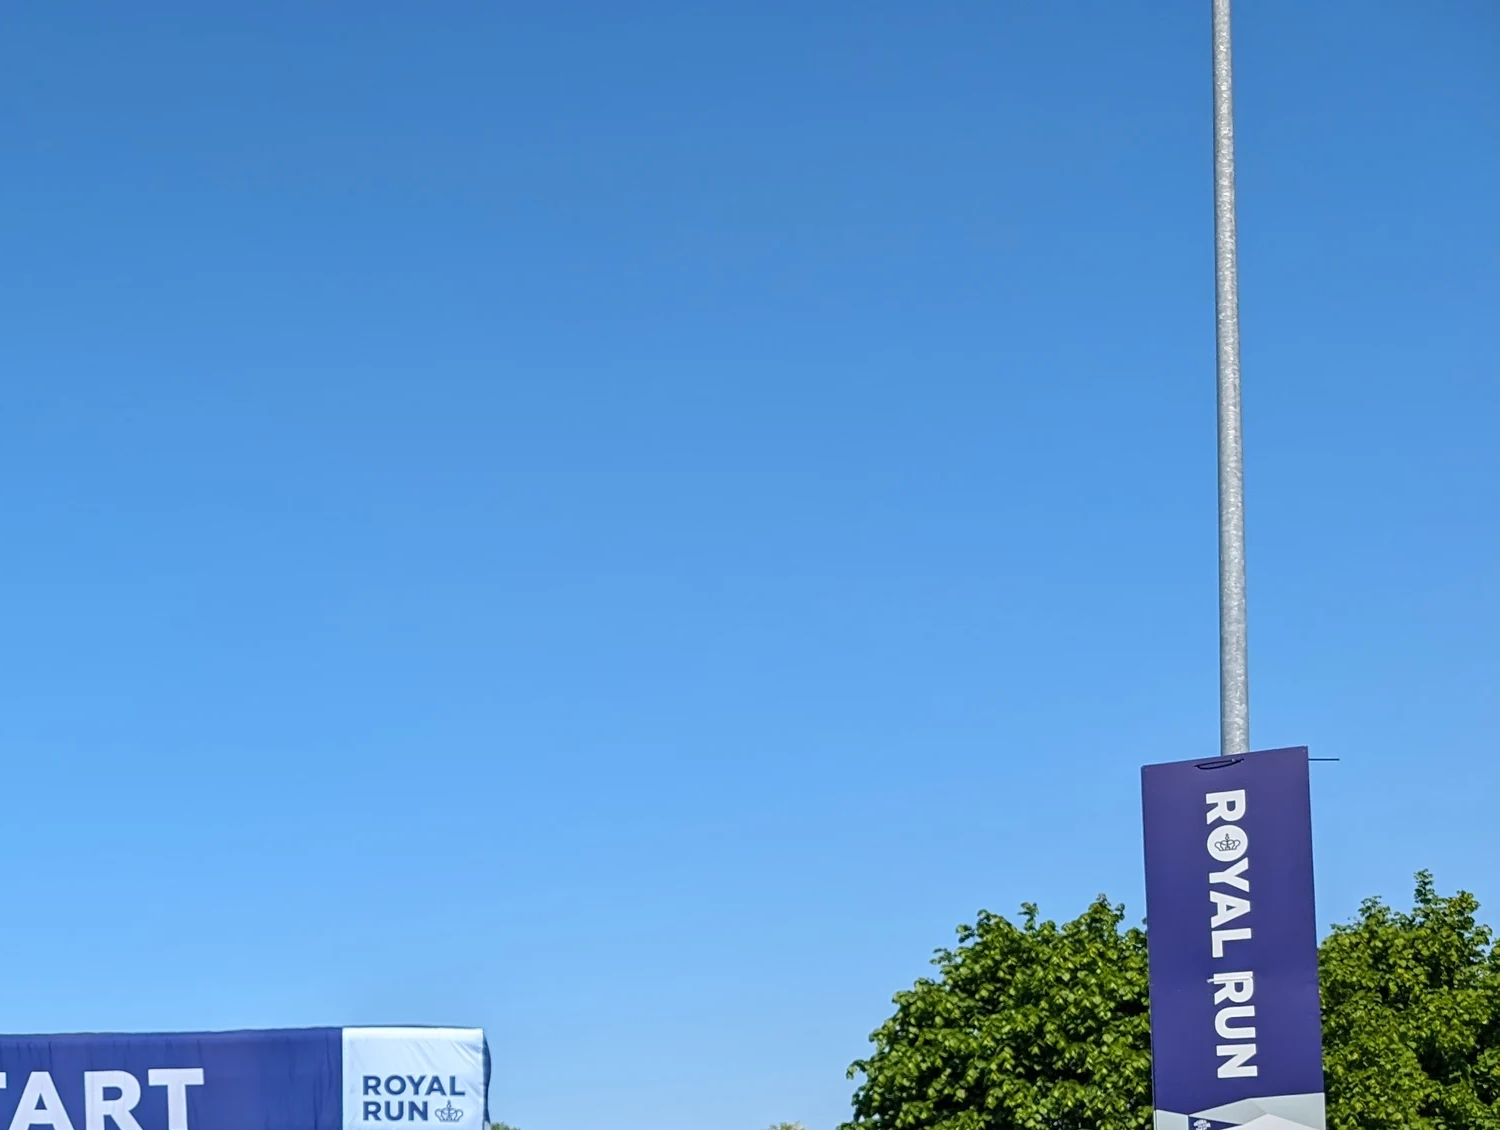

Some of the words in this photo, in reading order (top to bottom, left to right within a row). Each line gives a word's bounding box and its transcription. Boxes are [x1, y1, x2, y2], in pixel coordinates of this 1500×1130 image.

[1205, 788, 1253, 959] ROYAL
[1212, 970, 1259, 1079] RUN
[362, 1075, 466, 1096] ROYAL
[362, 1101, 429, 1122] RUN
